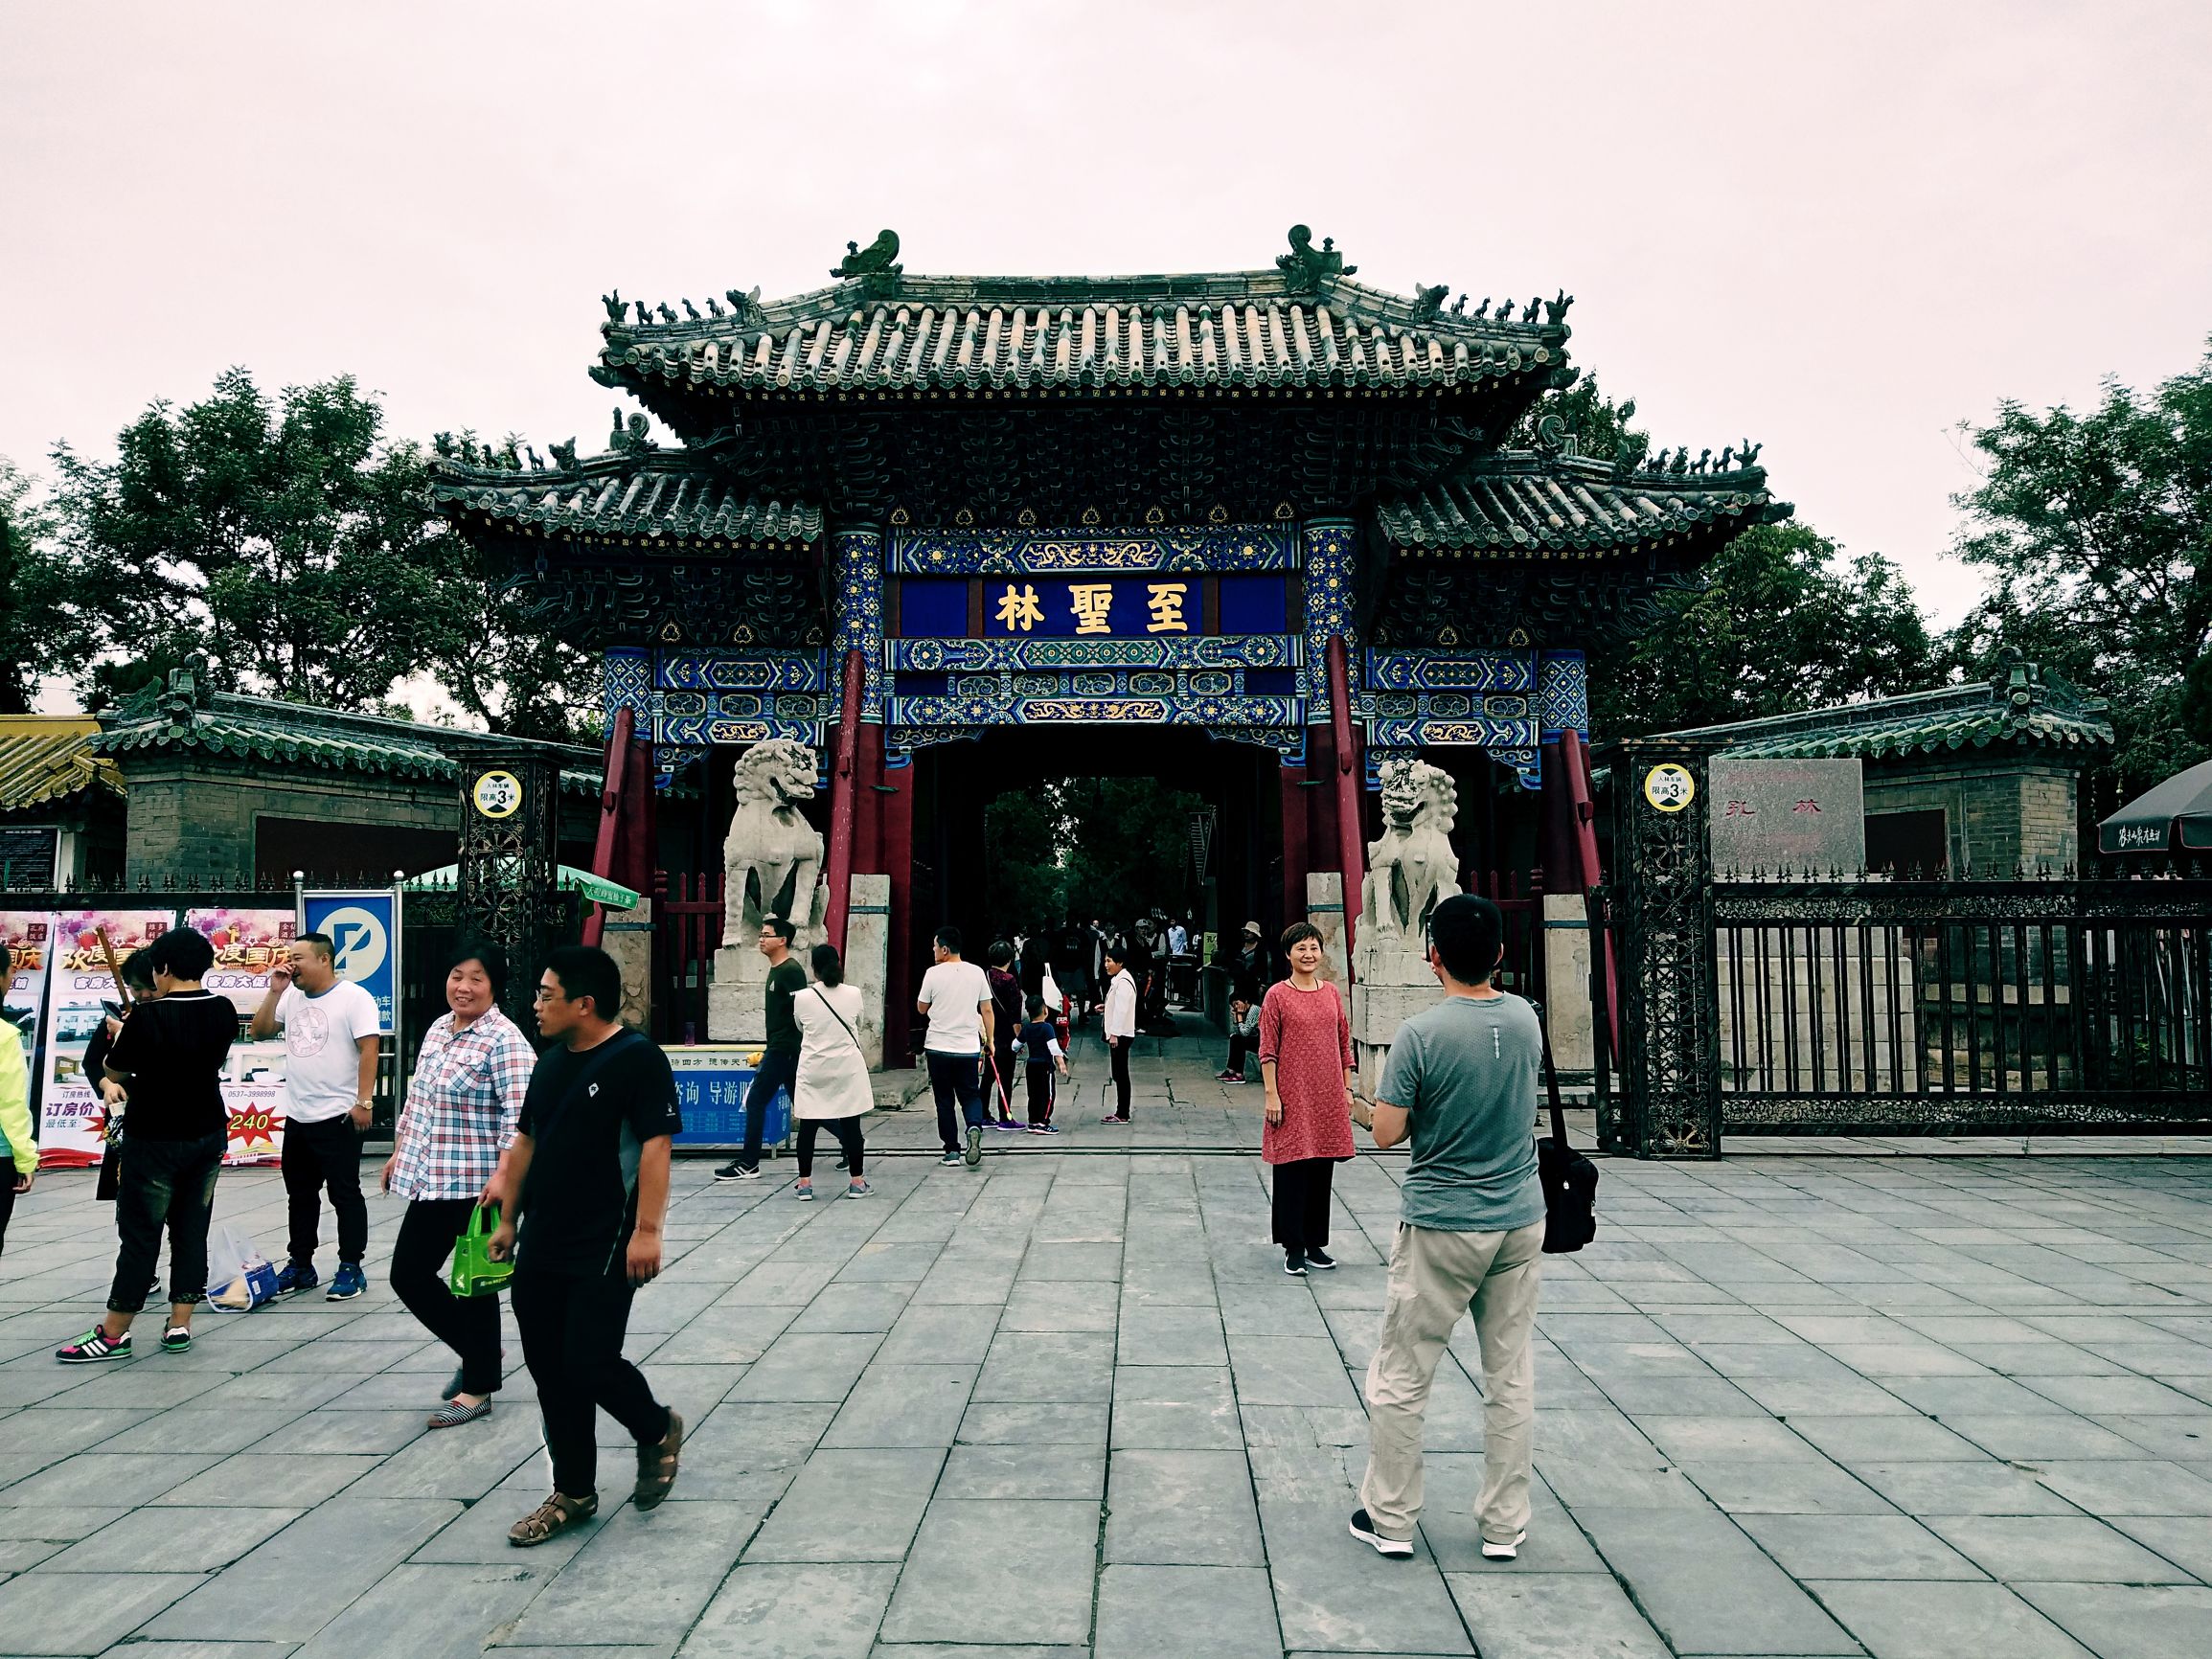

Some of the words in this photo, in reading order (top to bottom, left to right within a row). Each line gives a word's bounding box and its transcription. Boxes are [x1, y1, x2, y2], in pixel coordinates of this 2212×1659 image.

[480, 790, 515, 804] 限高3米
[1652, 784, 1688, 797] 限高3米
[74, 976, 130, 990] 客房大
[207, 975, 272, 989] 客房大促
[46, 1102, 94, 1117] 订房价
[230, 1114, 269, 1129] 240
